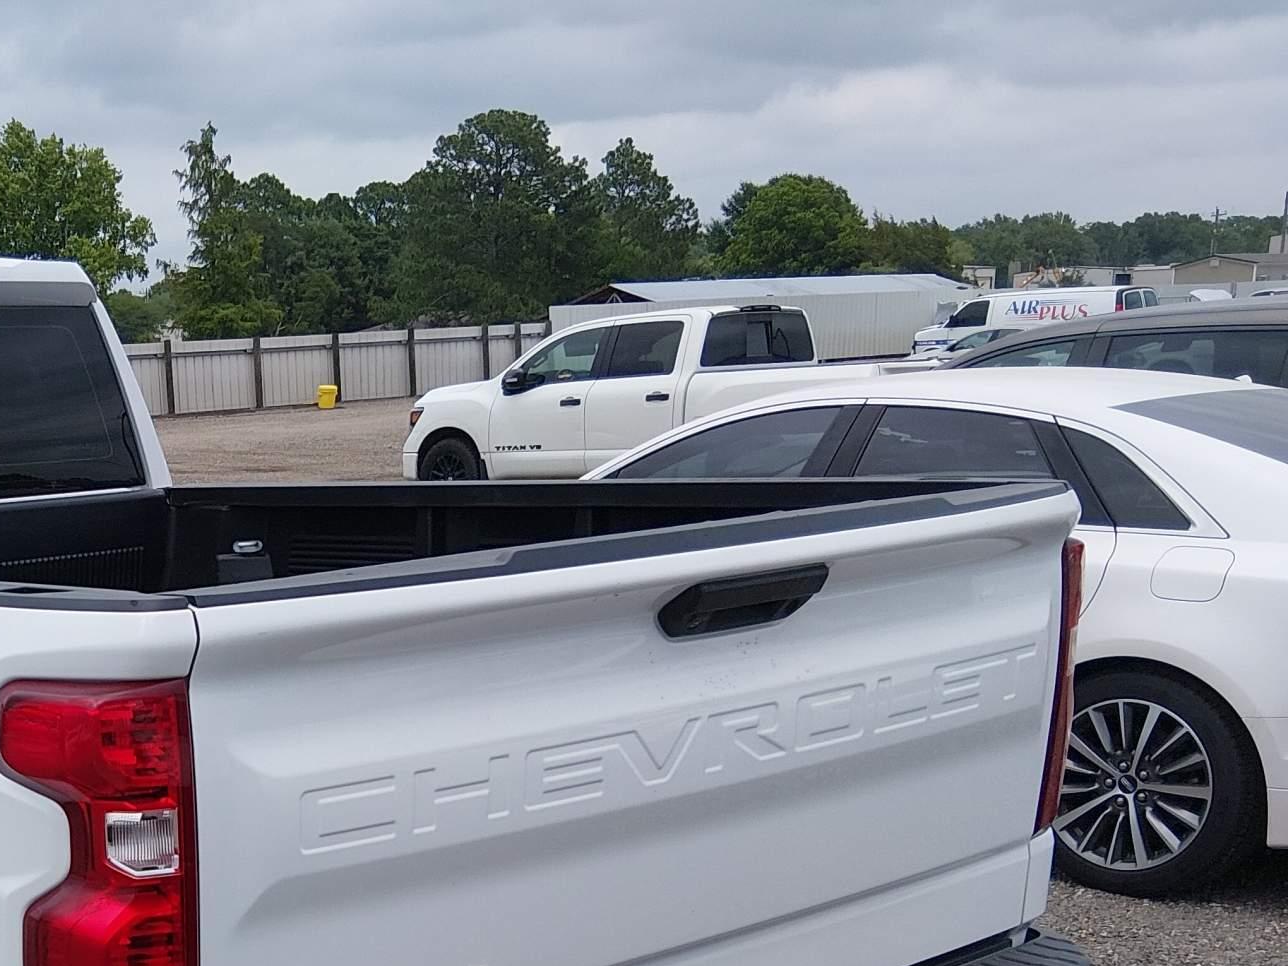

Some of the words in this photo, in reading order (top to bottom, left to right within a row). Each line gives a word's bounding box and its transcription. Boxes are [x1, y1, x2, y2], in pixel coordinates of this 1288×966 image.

[1005, 300, 1040, 315] AIR
[1038, 304, 1088, 320] PLUS
[300, 642, 1036, 855] CHEVROLET
